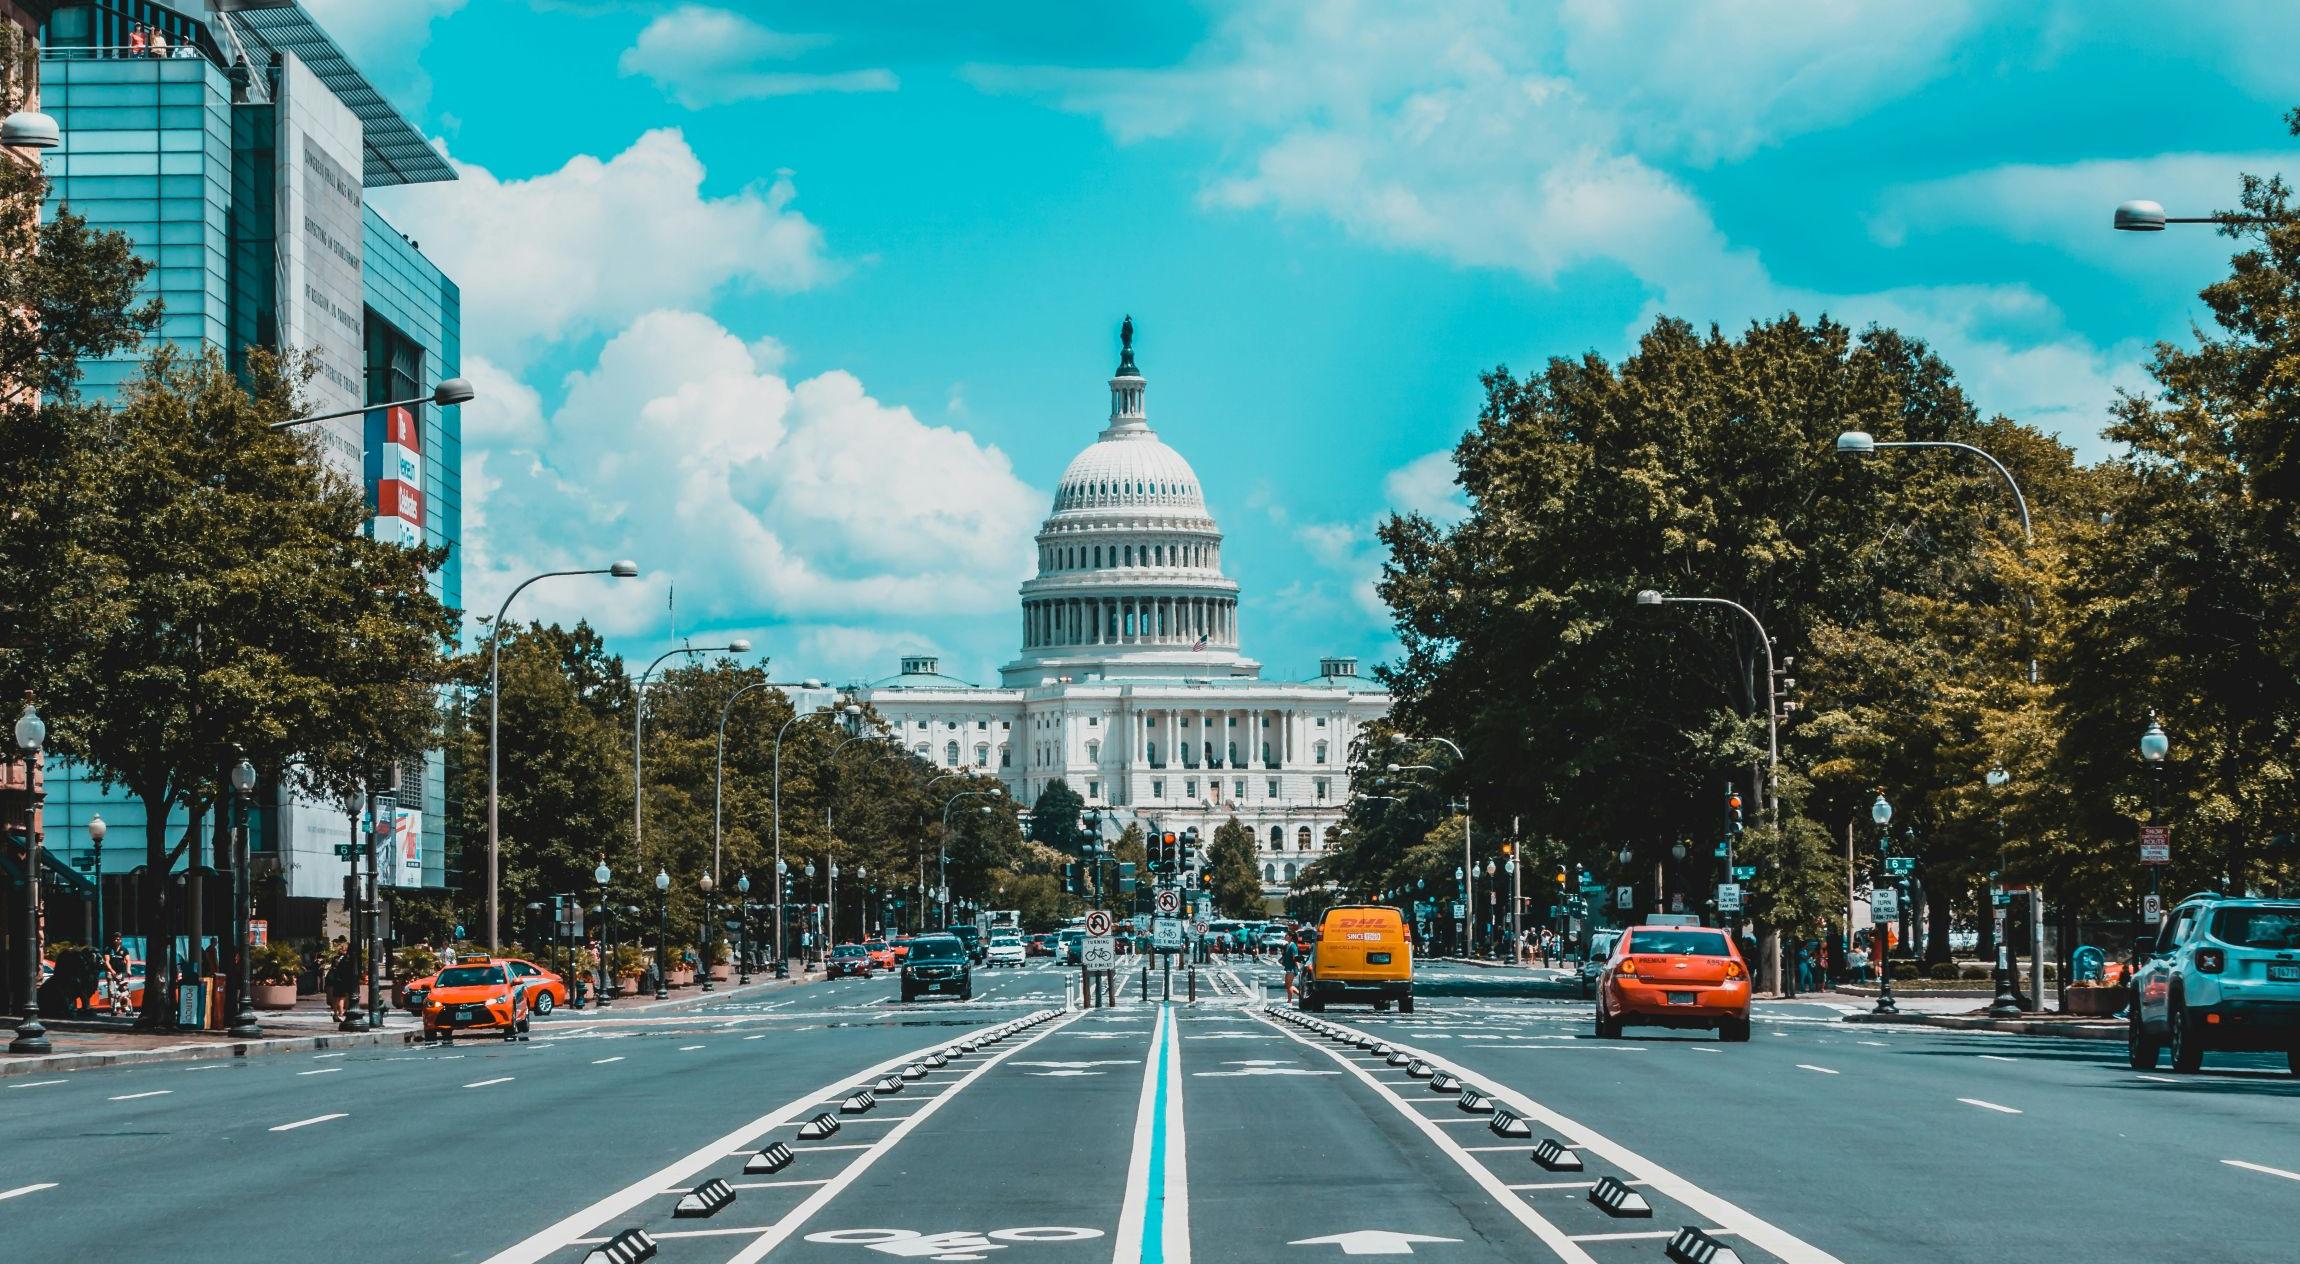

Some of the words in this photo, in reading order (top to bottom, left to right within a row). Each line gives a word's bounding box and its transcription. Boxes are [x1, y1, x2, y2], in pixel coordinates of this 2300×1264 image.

[341, 845, 348, 855] 6
[1892, 860, 1899, 868] 6
[1339, 918, 1388, 929] DHL
[1346, 932, 1364, 940] SINCE
[2275, 952, 2294, 960] Jeep
